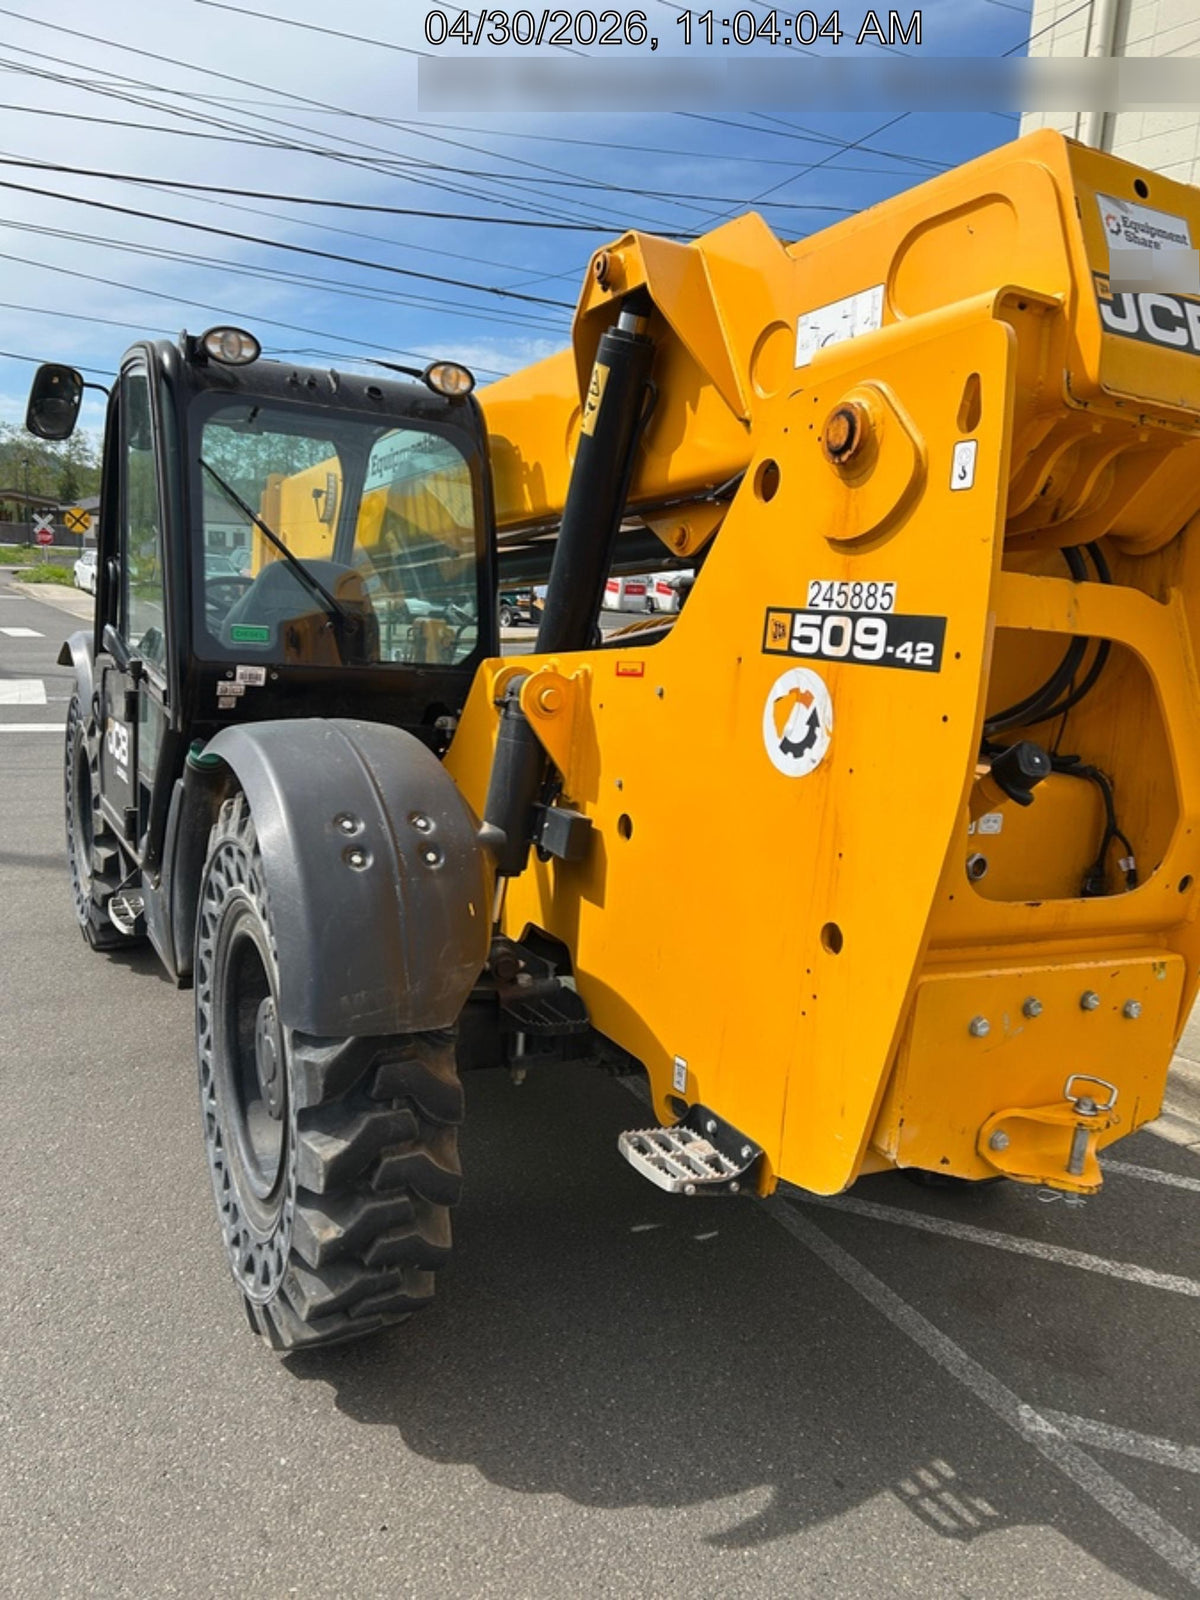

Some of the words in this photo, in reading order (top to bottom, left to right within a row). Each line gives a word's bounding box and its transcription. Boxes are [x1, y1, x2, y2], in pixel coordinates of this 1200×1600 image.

[1121, 214, 1188, 247] Equipment
[1123, 230, 1162, 250] Share
[808, 580, 894, 611] 245885
